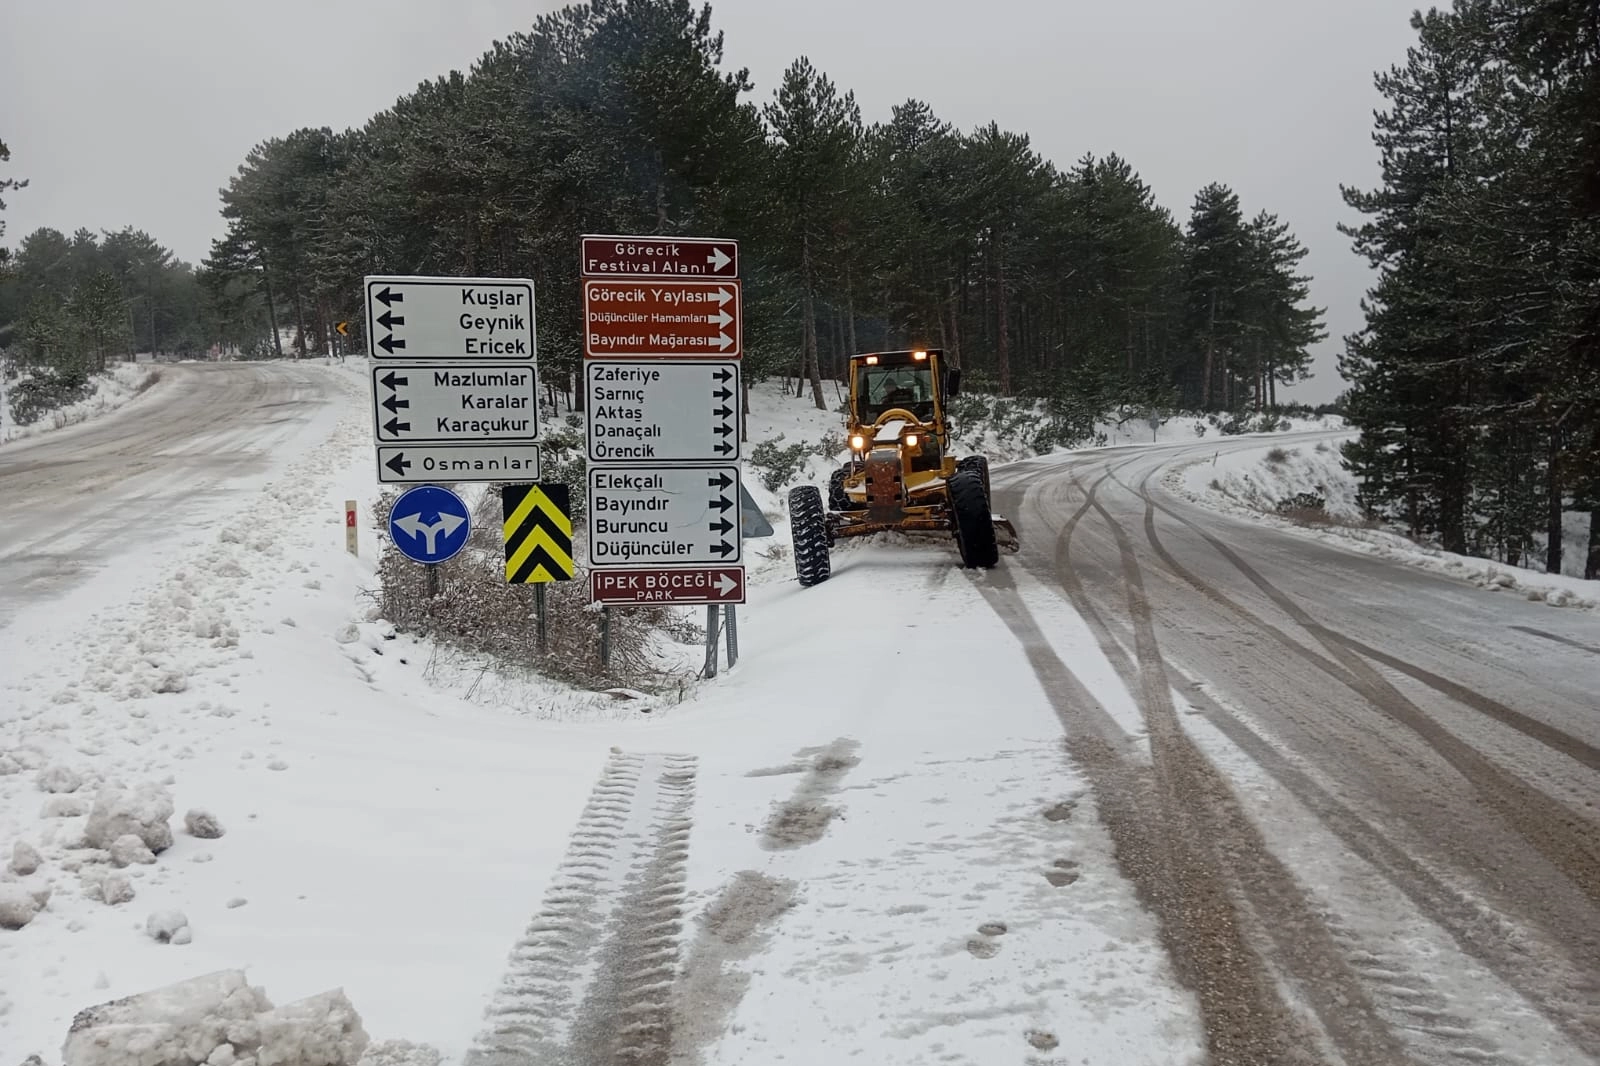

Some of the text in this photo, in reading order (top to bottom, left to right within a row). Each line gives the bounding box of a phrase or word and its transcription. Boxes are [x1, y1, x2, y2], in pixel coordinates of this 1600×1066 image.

[615, 243, 680, 256] Görecik
[589, 259, 706, 273] Festival Alanı
[462, 289, 524, 309] Kuşlar
[589, 288, 707, 306] Görecik Yaylası
[460, 314, 525, 334] Geynik
[590, 312, 707, 324] Düğüncüler Hamamları
[465, 338, 526, 354] Ericek
[591, 334, 707, 348] Bayındır Mağarası
[435, 372, 527, 386] Mazlumlar
[594, 368, 660, 385] Zaferiye
[462, 395, 528, 409] Karalar
[594, 388, 644, 403] Sarnıç
[595, 406, 642, 422] Aktaş
[437, 417, 529, 435] Karaçukur
[595, 424, 661, 440] Danaçalı
[595, 442, 655, 457] Örencik
[423, 457, 533, 470] Osmanlar
[596, 474, 663, 492] Elekçalı
[596, 496, 670, 515] Bayındır
[596, 520, 668, 533] Buruncu
[596, 541, 694, 560] Düğüncüler
[597, 572, 712, 589] İPEK BÖCEĞİ
[637, 591, 673, 600] PARK
